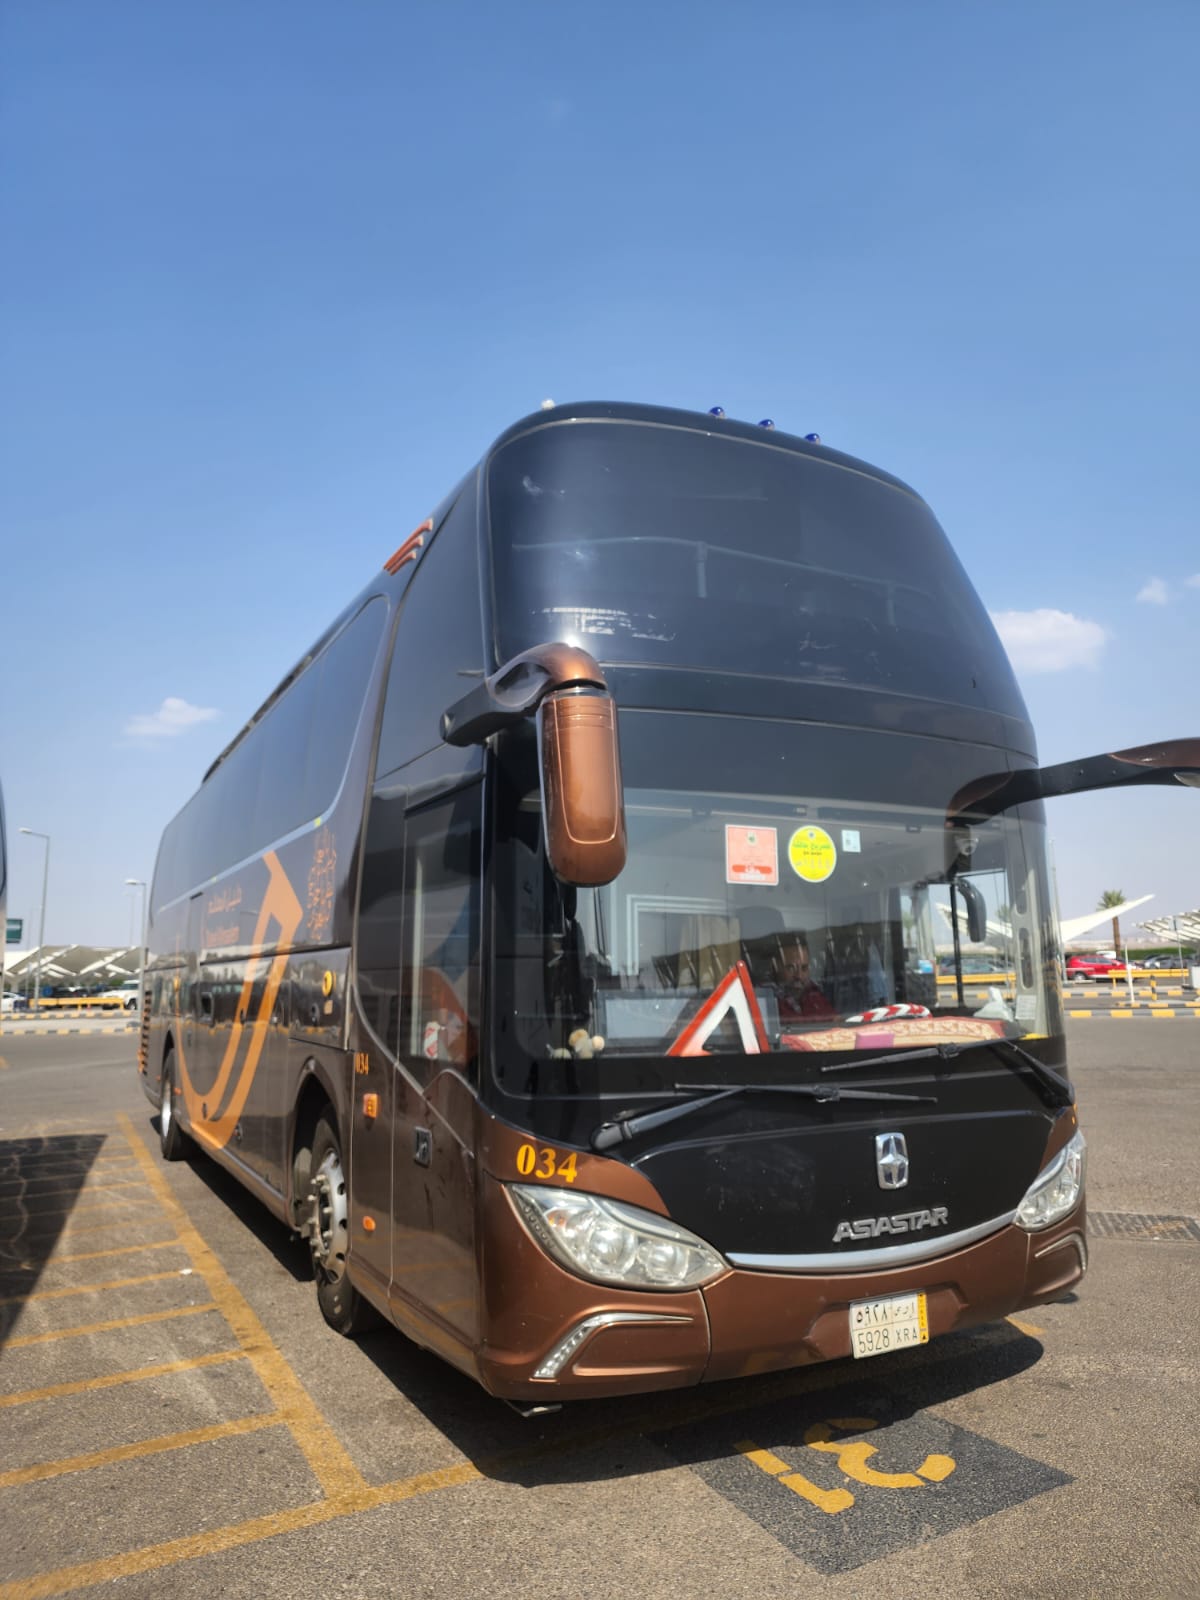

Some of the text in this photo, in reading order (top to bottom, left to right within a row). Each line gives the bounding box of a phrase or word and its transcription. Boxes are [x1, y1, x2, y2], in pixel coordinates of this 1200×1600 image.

[354, 1052, 369, 1075] 034
[516, 1144, 578, 1183] 034
[832, 1206, 949, 1243] ASIASTAR
[858, 1327, 918, 1353] 5928 XRA
